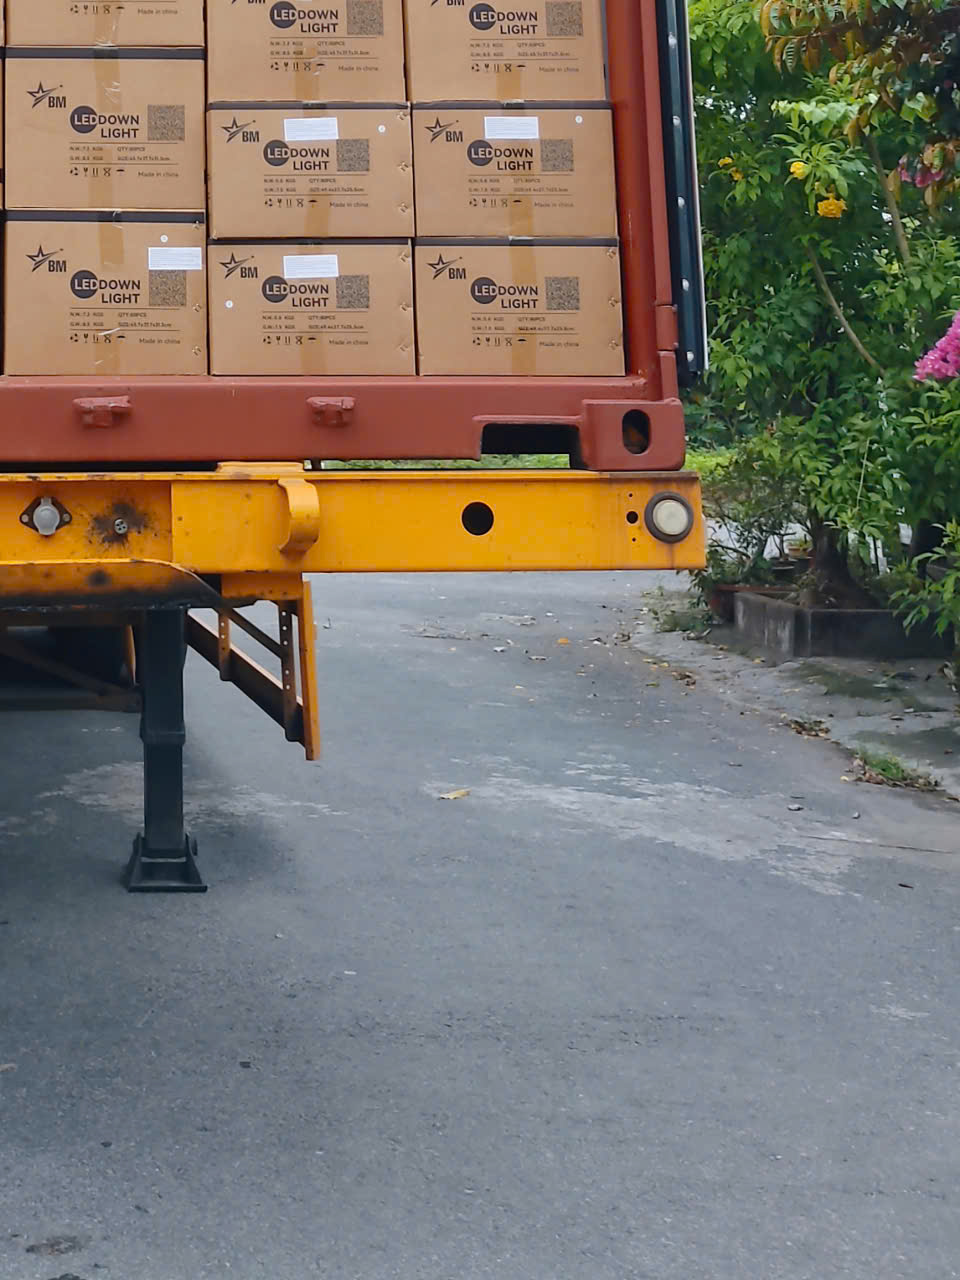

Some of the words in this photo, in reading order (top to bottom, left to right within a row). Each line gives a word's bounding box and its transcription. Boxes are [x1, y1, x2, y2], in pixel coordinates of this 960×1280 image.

[300, 23, 339, 33] LIGHT
[500, 24, 538, 35] LIGHT
[48, 96, 66, 108] BM
[101, 128, 139, 138] LIGHT
[242, 131, 260, 142] BM
[445, 131, 463, 142] BM
[293, 160, 329, 171] LIGHT
[497, 161, 533, 170] LIGHT
[48, 259, 66, 273] BM
[240, 266, 258, 279] BM
[448, 268, 466, 279] BM
[101, 293, 141, 304] LIGHT
[292, 297, 329, 308] LIGHT
[501, 299, 538, 308] LIGHT
